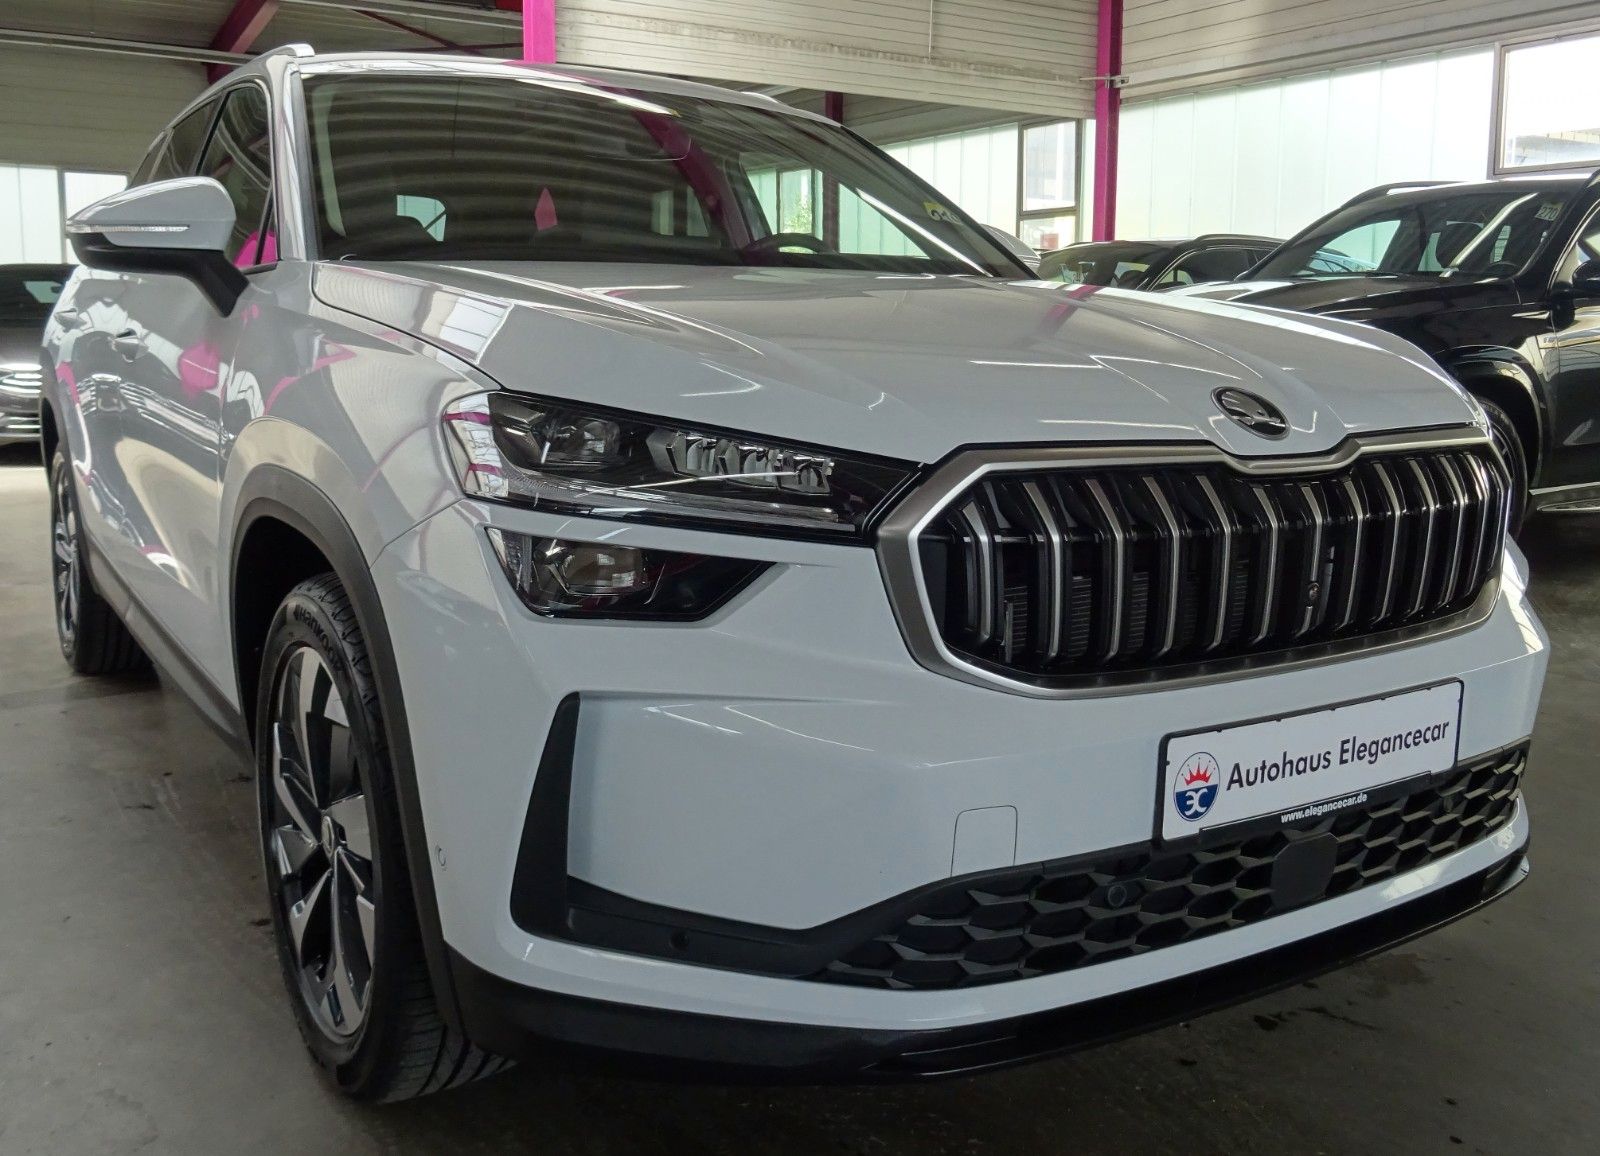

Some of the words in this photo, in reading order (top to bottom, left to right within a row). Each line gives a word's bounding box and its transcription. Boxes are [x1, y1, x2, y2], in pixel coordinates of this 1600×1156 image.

[1225, 750, 1331, 791] Autohaus
[1338, 719, 1450, 765] Elegancecar
[1280, 792, 1368, 824] www.elegancecar.de
